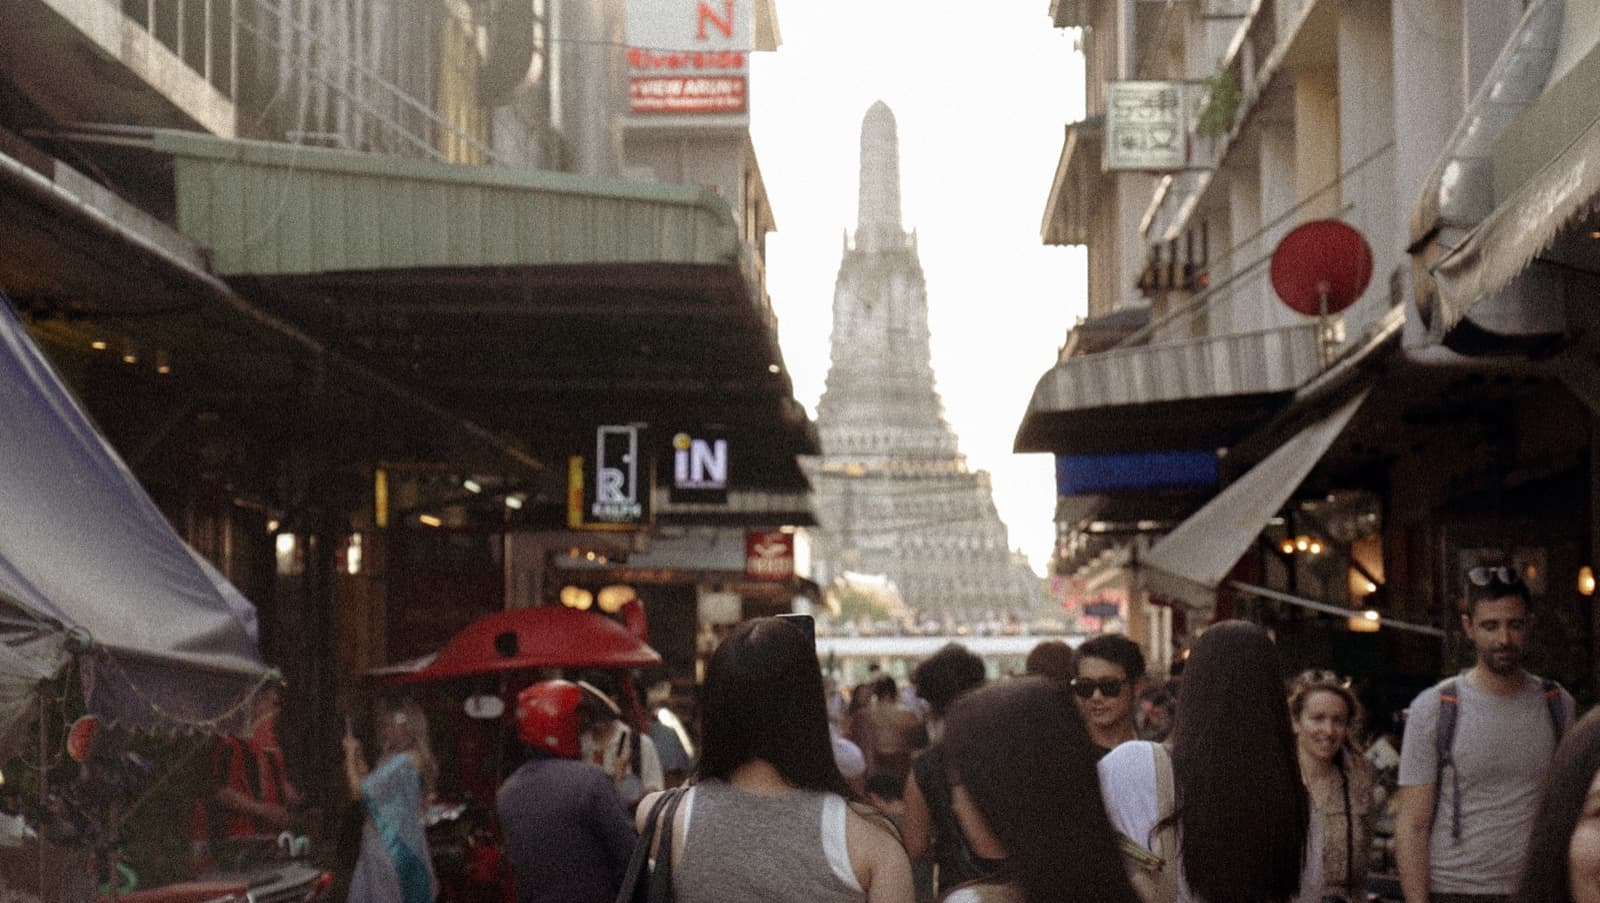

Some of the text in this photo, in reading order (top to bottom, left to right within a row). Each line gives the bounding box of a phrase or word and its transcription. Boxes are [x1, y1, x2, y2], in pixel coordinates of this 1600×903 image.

[697, 0, 733, 40] N
[627, 48, 744, 69] Riverside
[673, 432, 728, 481] iN
[598, 467, 625, 502] R
